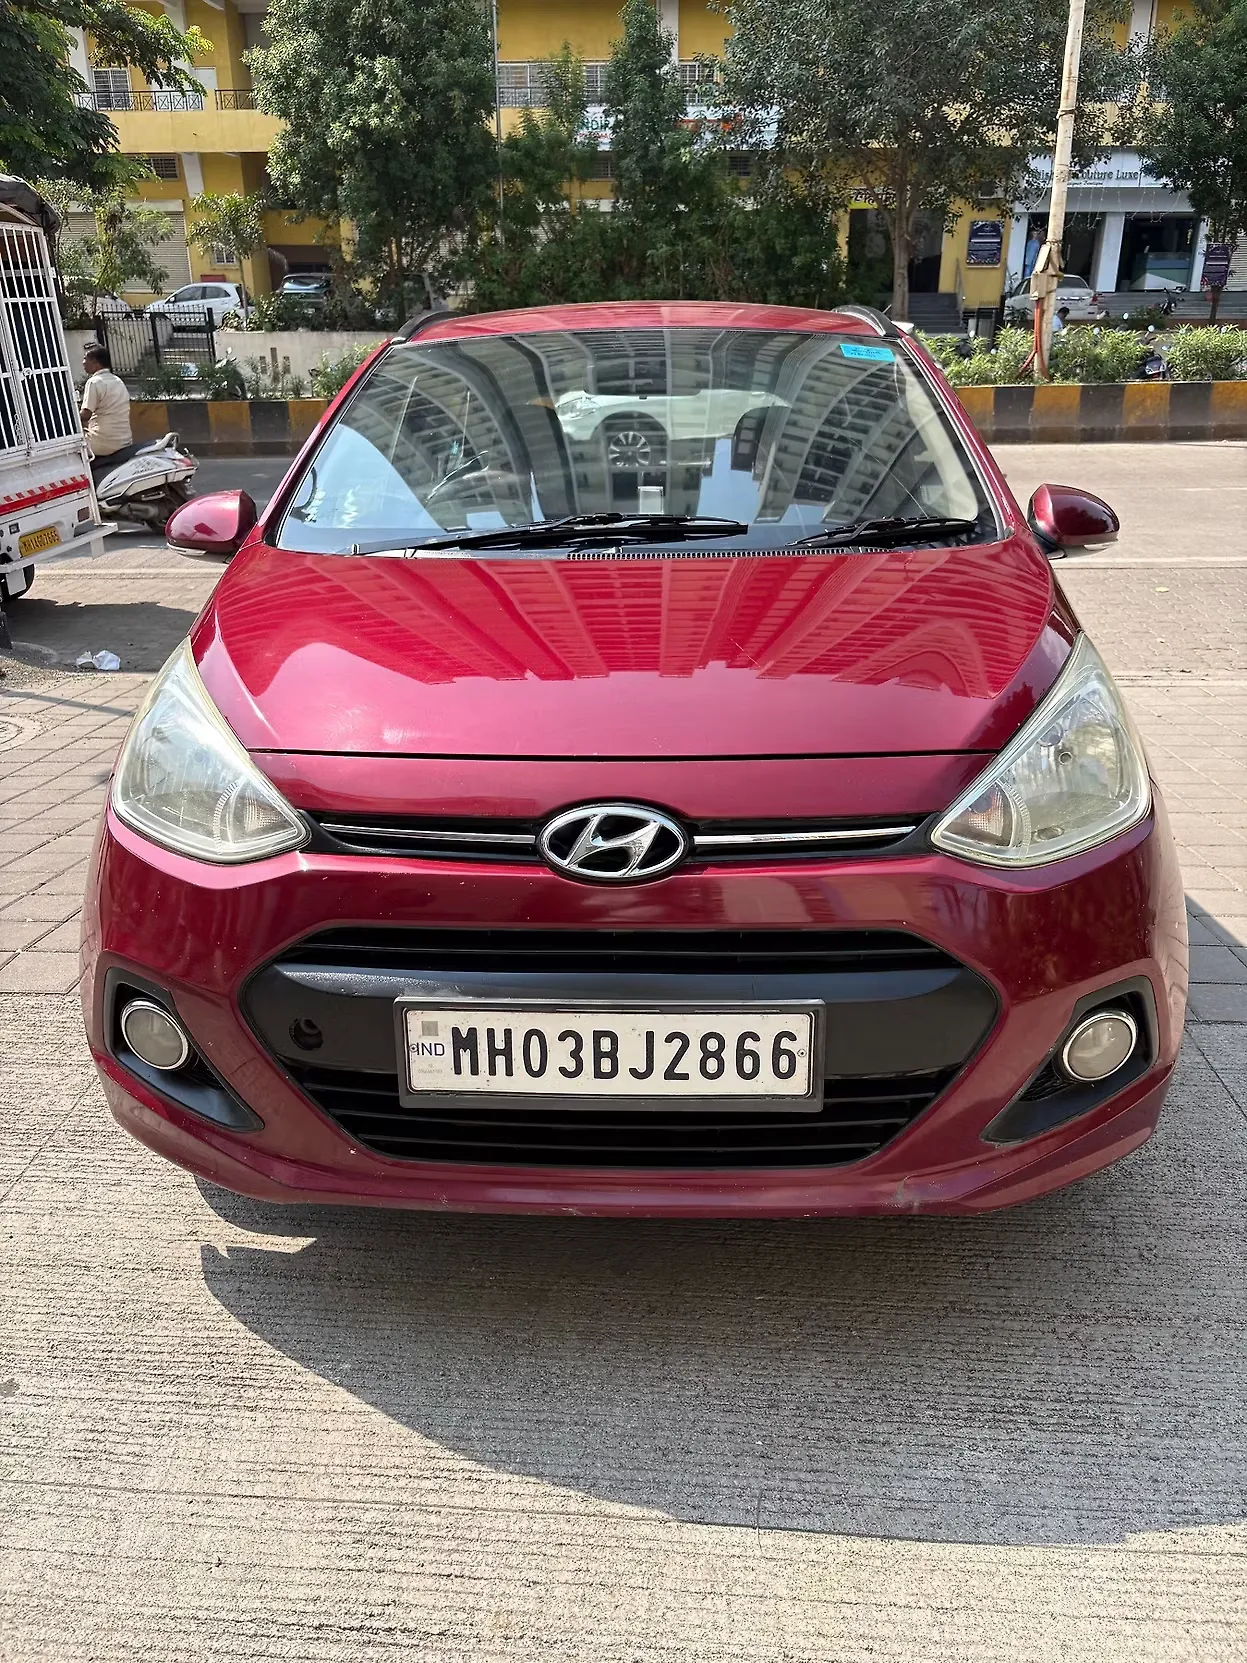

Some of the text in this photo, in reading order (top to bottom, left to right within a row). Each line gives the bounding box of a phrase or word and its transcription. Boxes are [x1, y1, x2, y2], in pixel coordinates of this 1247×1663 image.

[1115, 169, 1139, 180] Luxe
[417, 1042, 445, 1056] IND
[452, 1027, 797, 1080] MH03BJ2866
